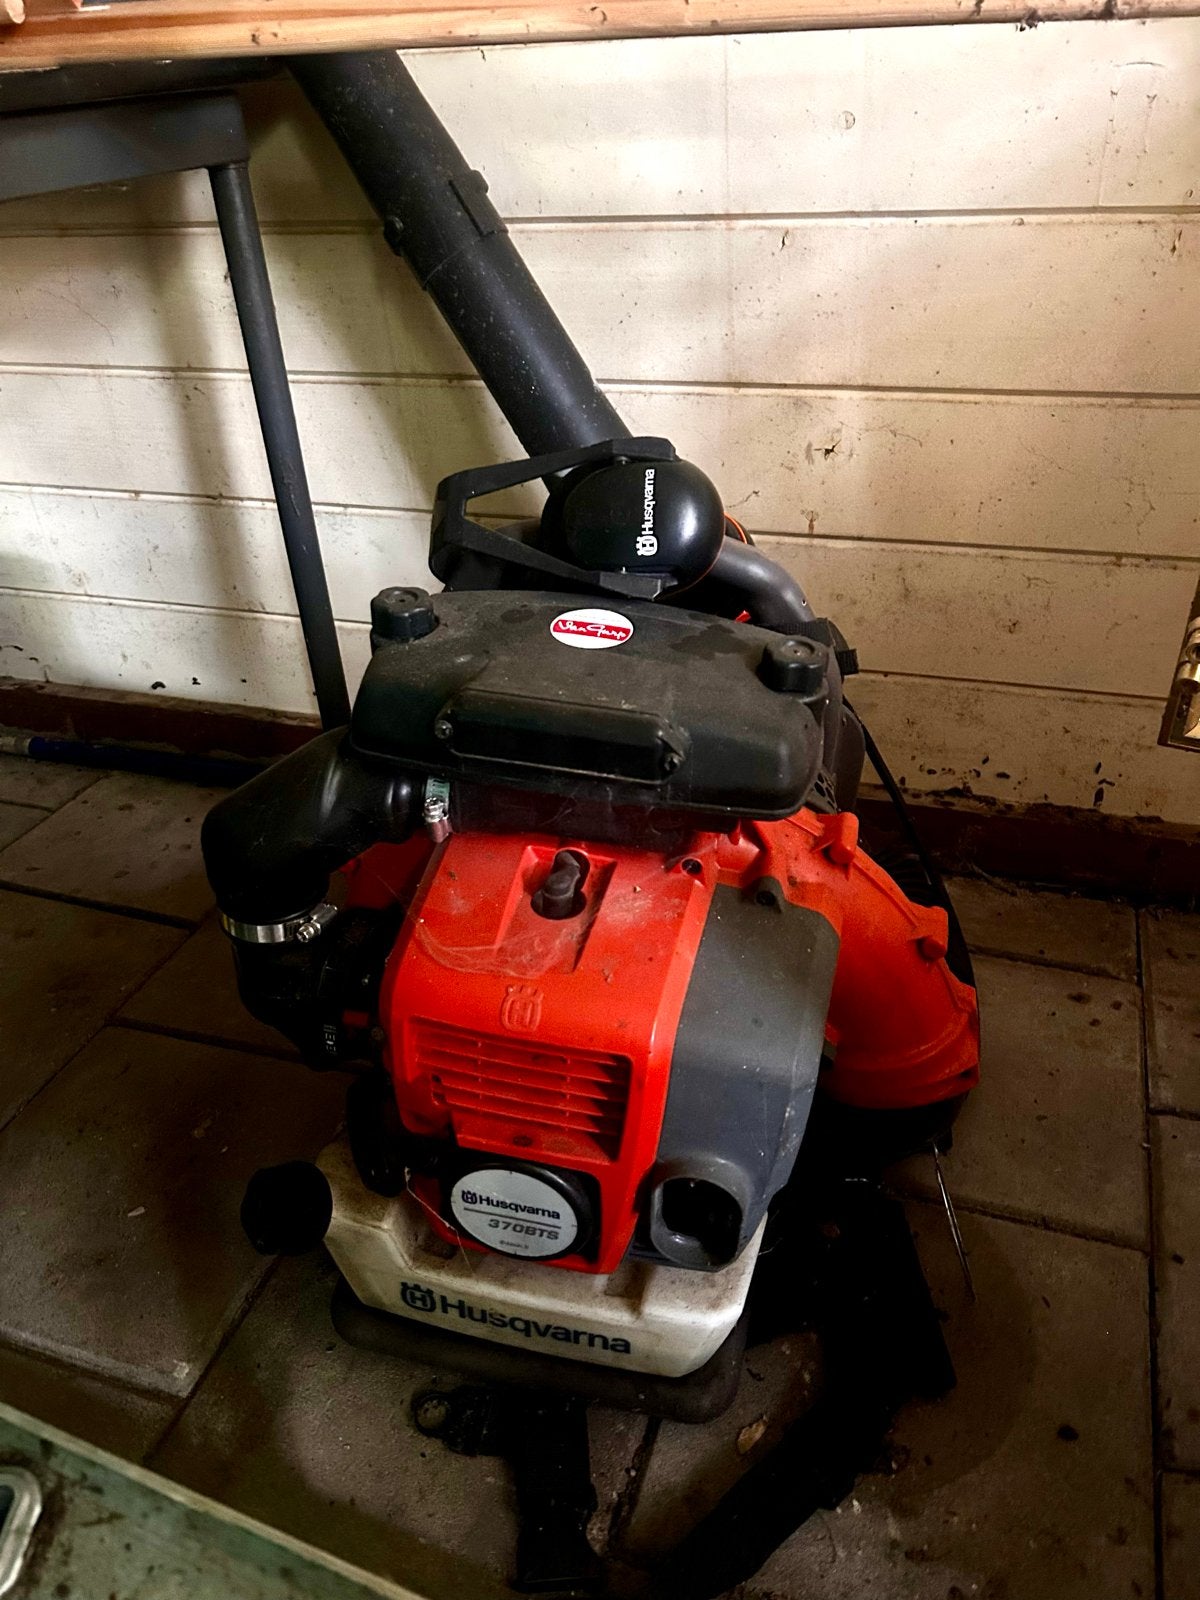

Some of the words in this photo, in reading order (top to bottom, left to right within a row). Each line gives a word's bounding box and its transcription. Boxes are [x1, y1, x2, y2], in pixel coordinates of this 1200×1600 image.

[641, 468, 656, 535] Husqvarna
[558, 620, 588, 633] Van
[479, 1195, 560, 1219] Husqvarna
[488, 1219, 559, 1240] 370BTS
[441, 1295, 631, 1354] Husqvarna
